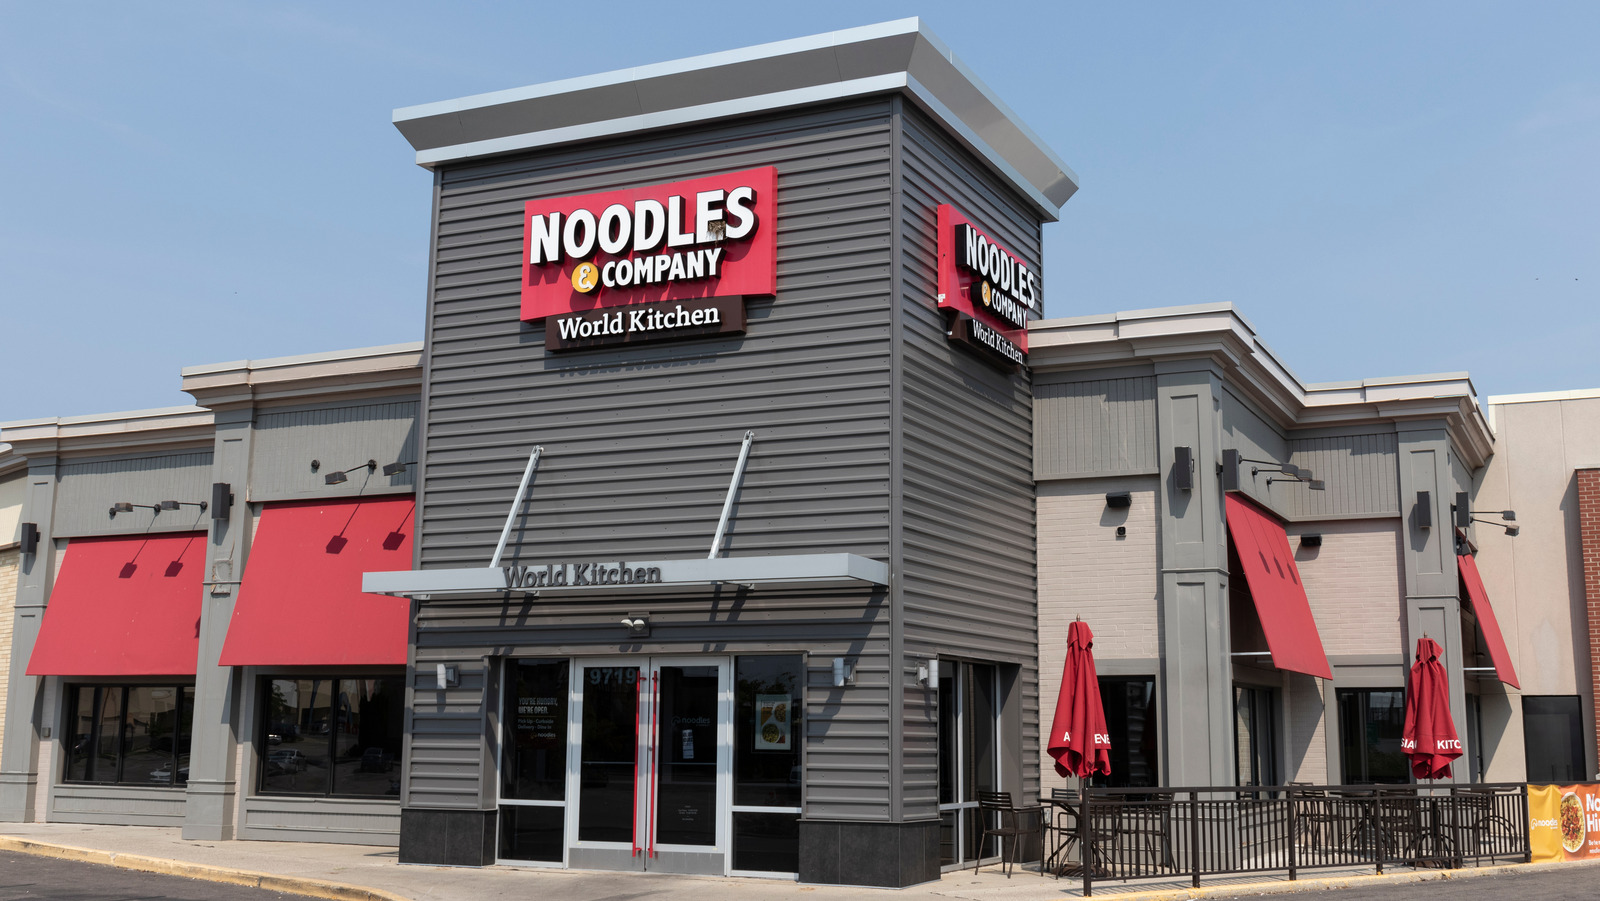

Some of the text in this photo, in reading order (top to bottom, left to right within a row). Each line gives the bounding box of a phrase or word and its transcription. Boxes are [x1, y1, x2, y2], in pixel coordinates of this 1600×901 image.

[530, 186, 756, 265] NOODLES
[575, 247, 722, 291] & COMPANY
[965, 223, 1036, 309] NOODLES
[557, 304, 720, 340] World Kitchen
[982, 282, 1028, 330] & COMPANY
[972, 318, 1023, 364] World Kitchen
[502, 561, 662, 588] World Kitchen
[589, 667, 637, 685] 9719
[517, 706, 534, 714] WE'RE
[682, 716, 710, 724] noodles
